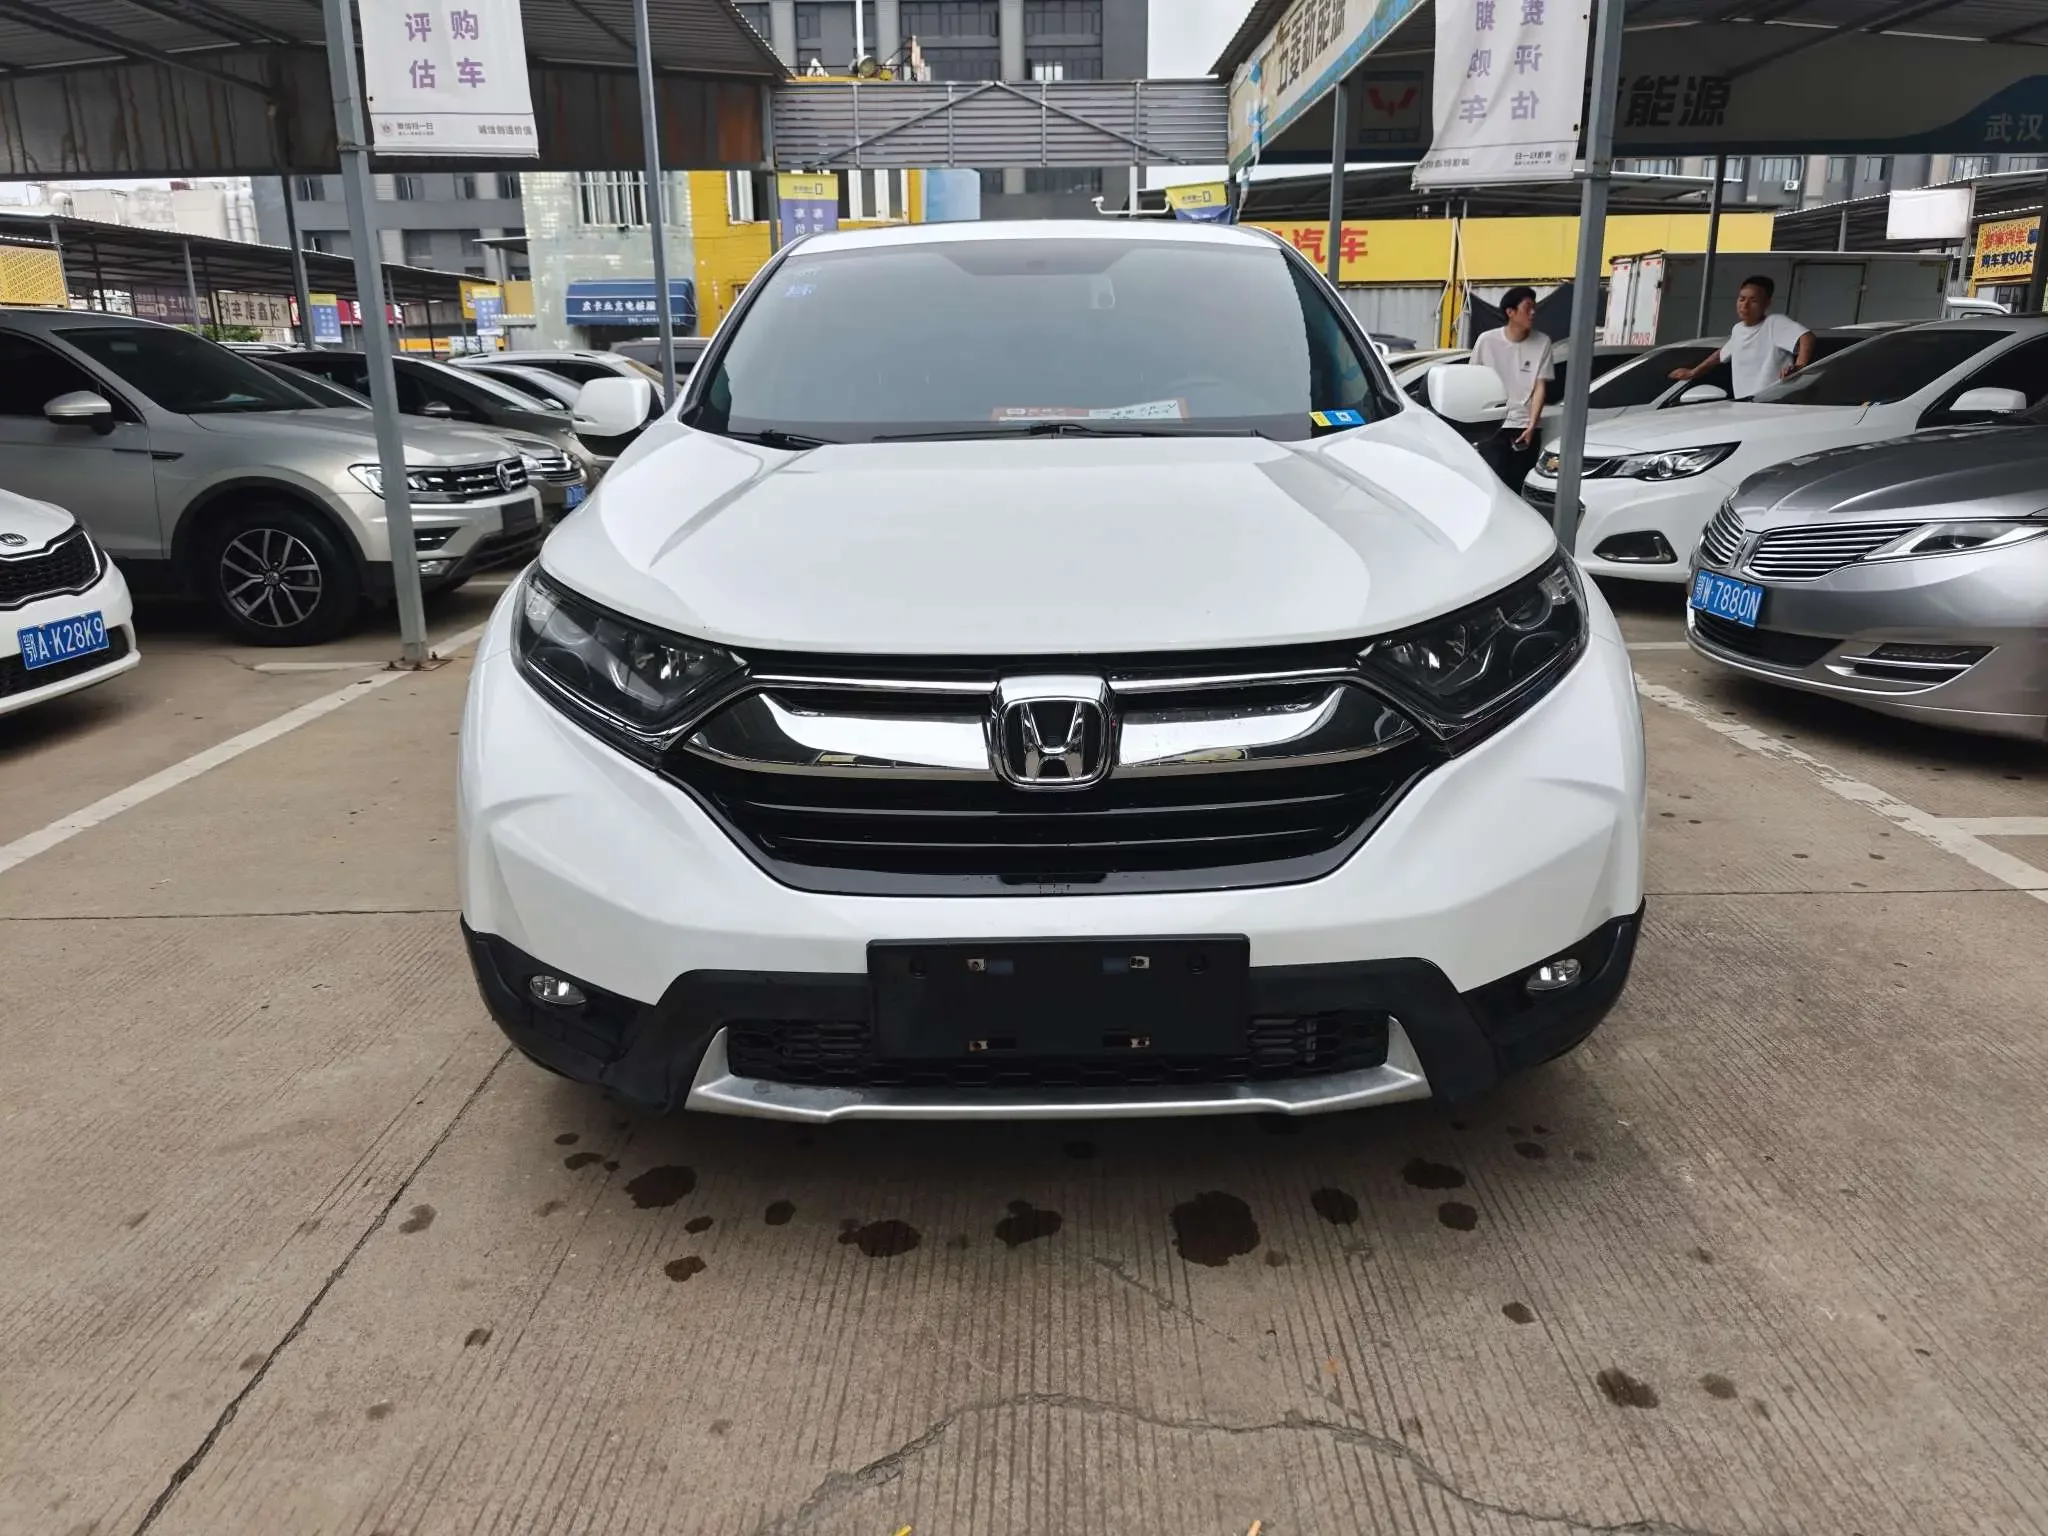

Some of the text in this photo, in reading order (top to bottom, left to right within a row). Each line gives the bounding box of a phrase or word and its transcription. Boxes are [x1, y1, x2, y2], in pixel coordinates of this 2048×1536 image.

[1618, 74, 1732, 127] 能源
[1984, 112, 2044, 143] 武汉
[1270, 227, 1369, 264] 汽车
